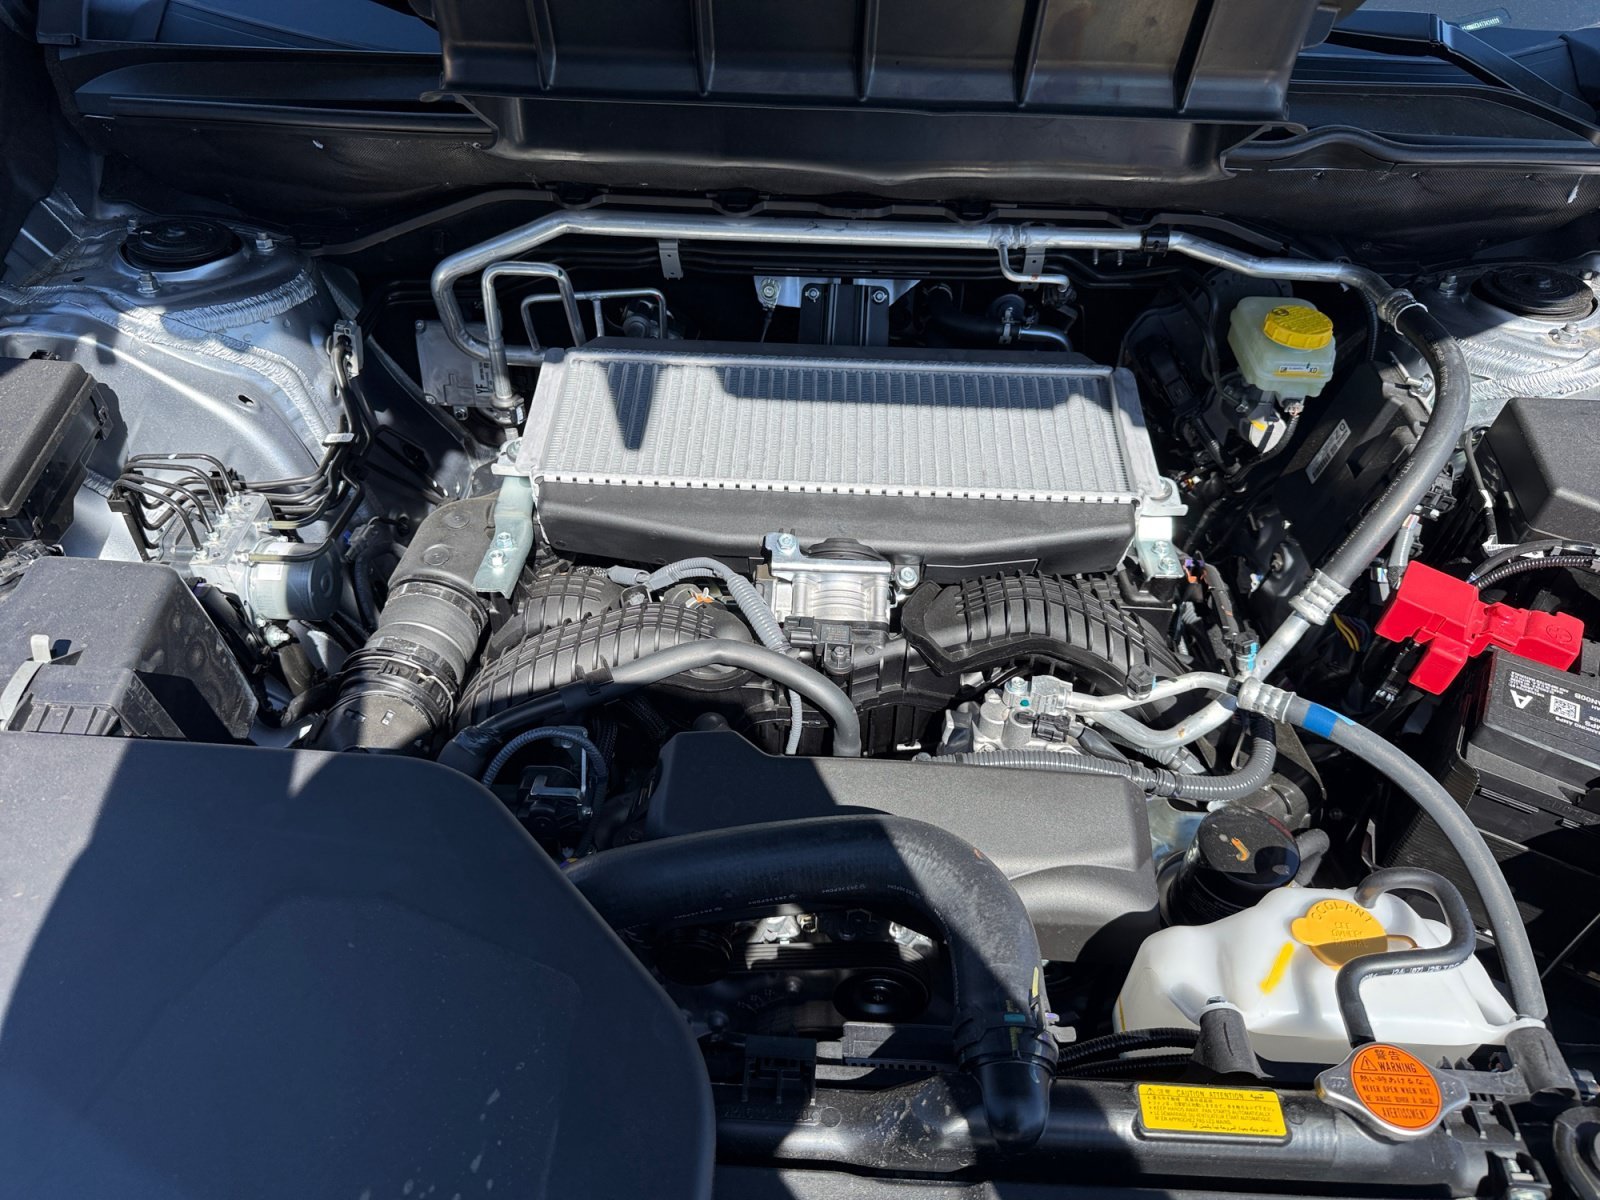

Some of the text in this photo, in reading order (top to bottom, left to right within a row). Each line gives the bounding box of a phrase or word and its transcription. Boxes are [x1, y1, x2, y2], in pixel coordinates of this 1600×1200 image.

[1556, 716, 1573, 725] AMPS
[1312, 902, 1372, 922] COOLANT
[1375, 1049, 1400, 1061] 警告
[1378, 1062, 1416, 1073] WARNING
[1210, 1091, 1244, 1099] ATTENTION
